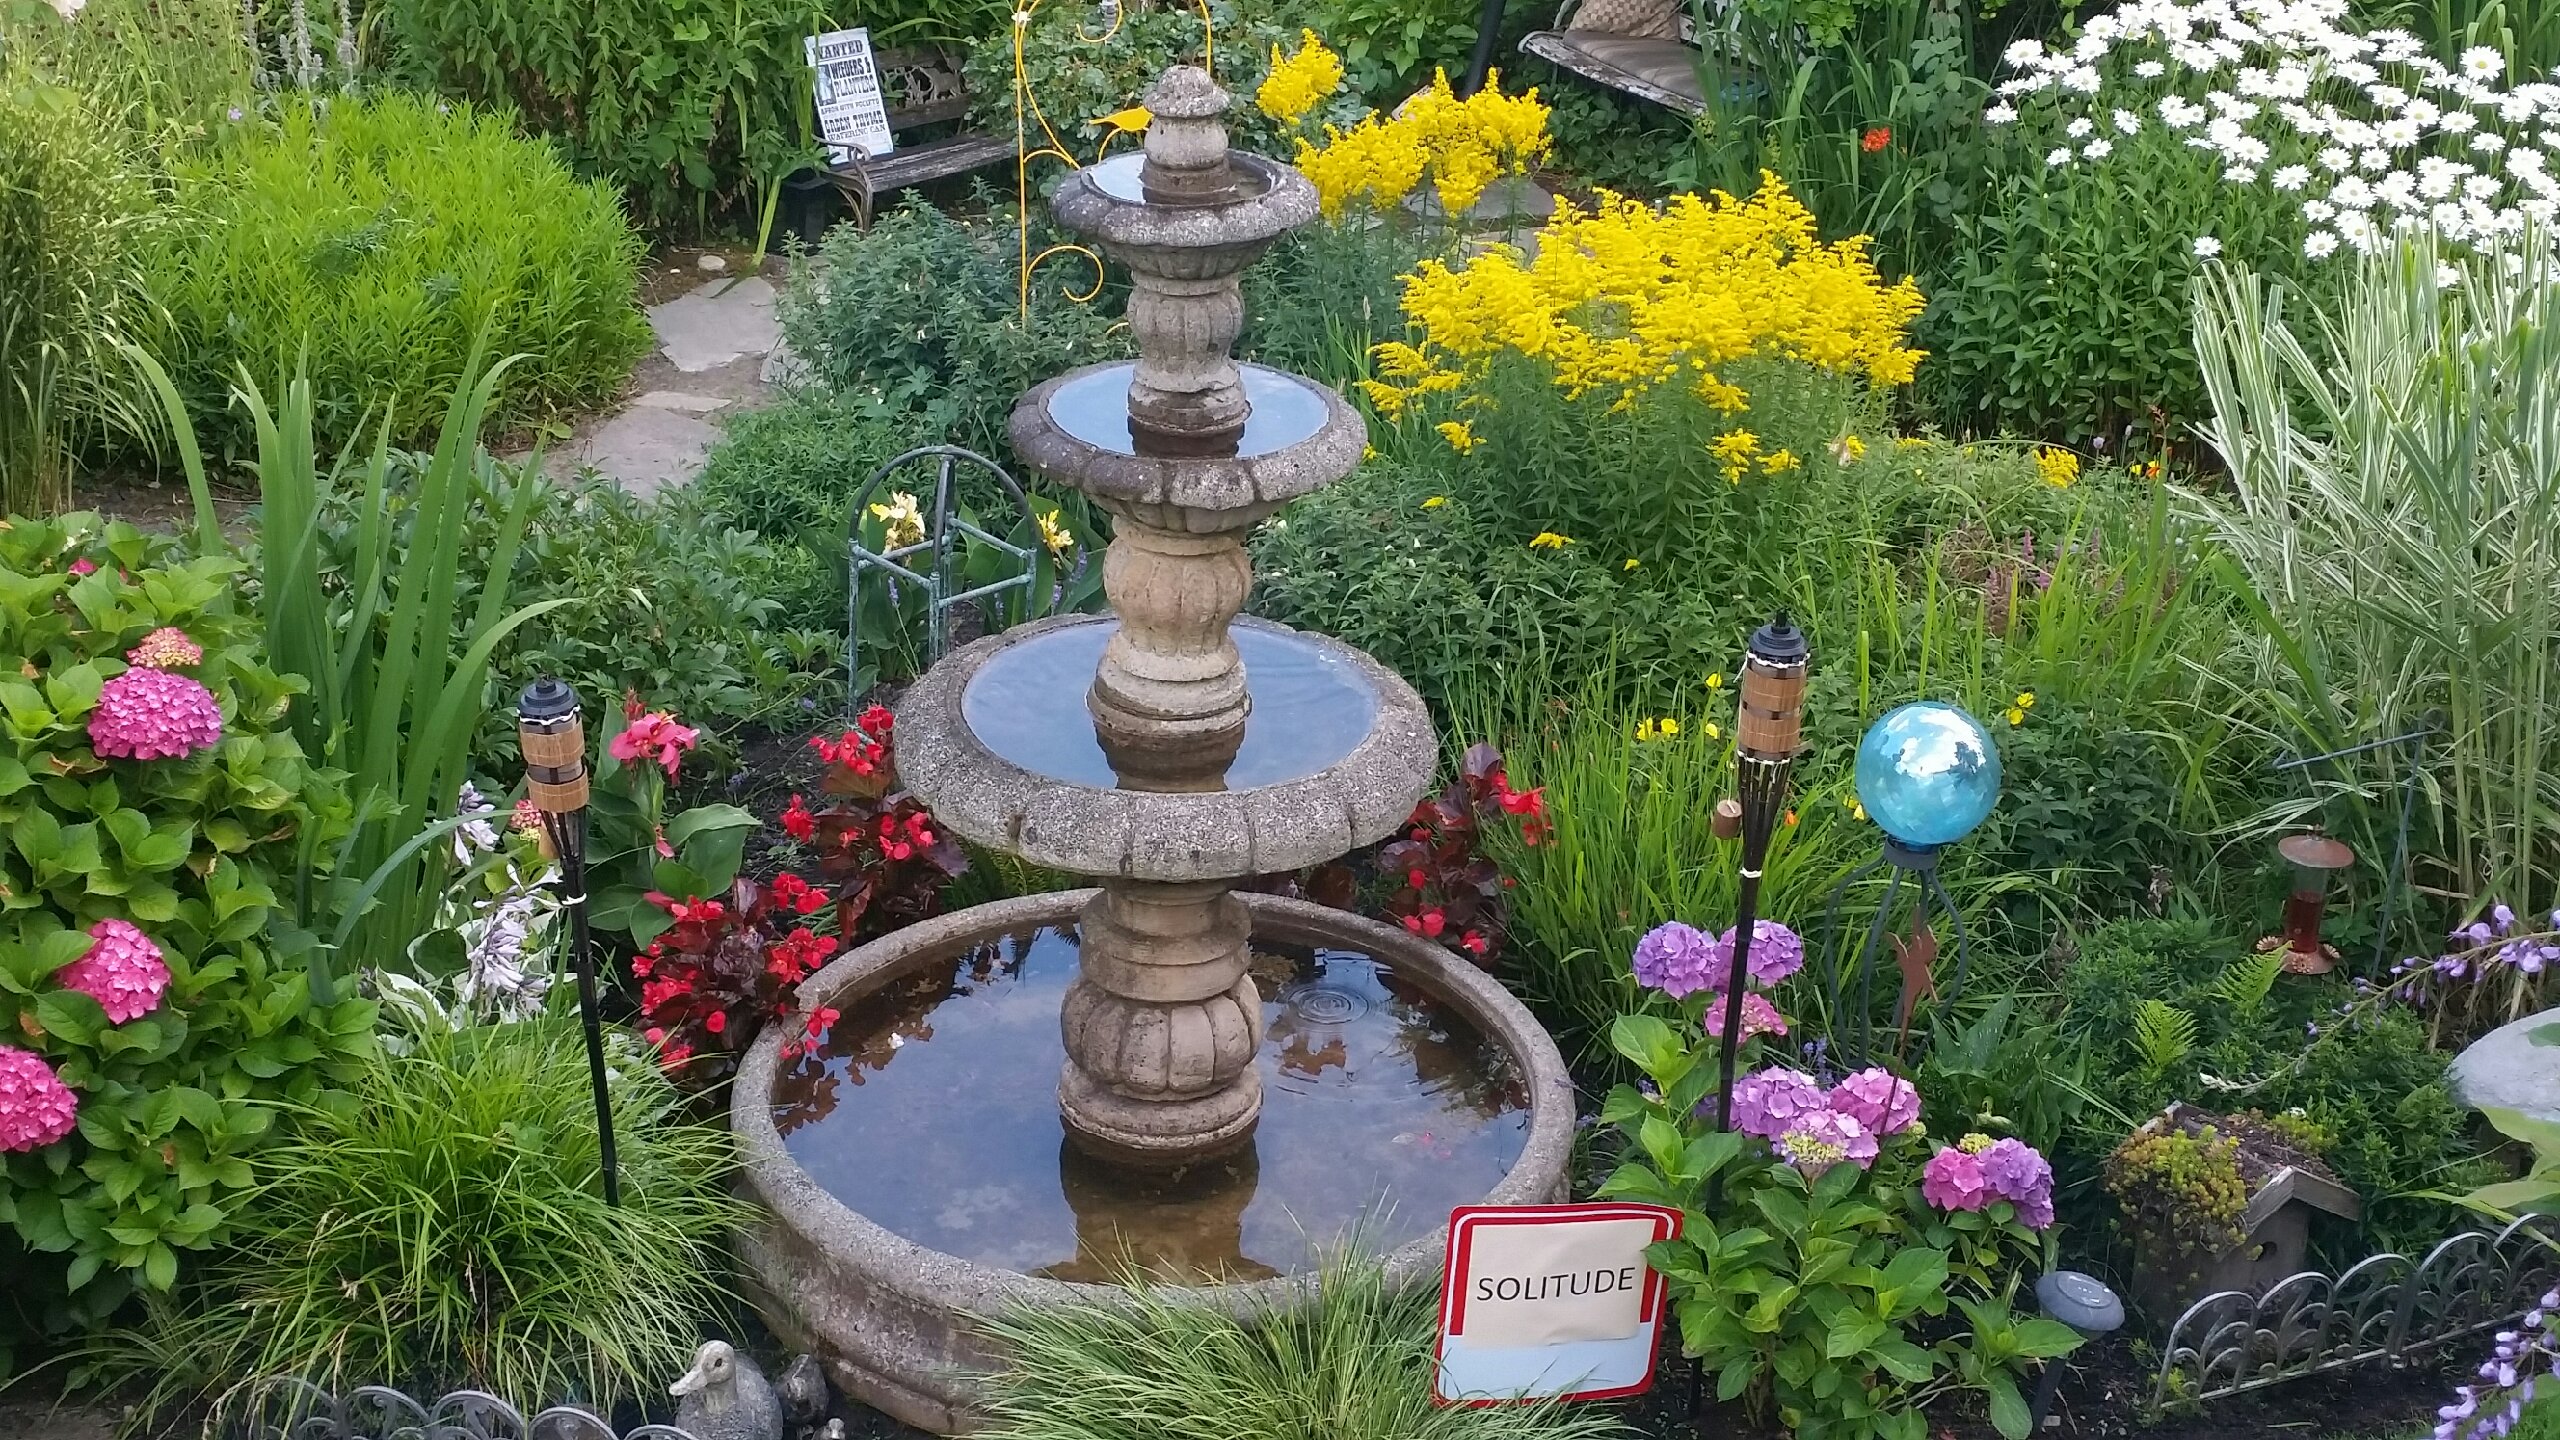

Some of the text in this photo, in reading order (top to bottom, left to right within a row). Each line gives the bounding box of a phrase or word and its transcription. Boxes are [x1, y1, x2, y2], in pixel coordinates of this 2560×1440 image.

[812, 40, 863, 59] WANTED
[834, 74, 876, 97] PLANTERS
[828, 123, 886, 141] WATERING CAN
[1476, 1267, 1636, 1301] SOLITUDE
